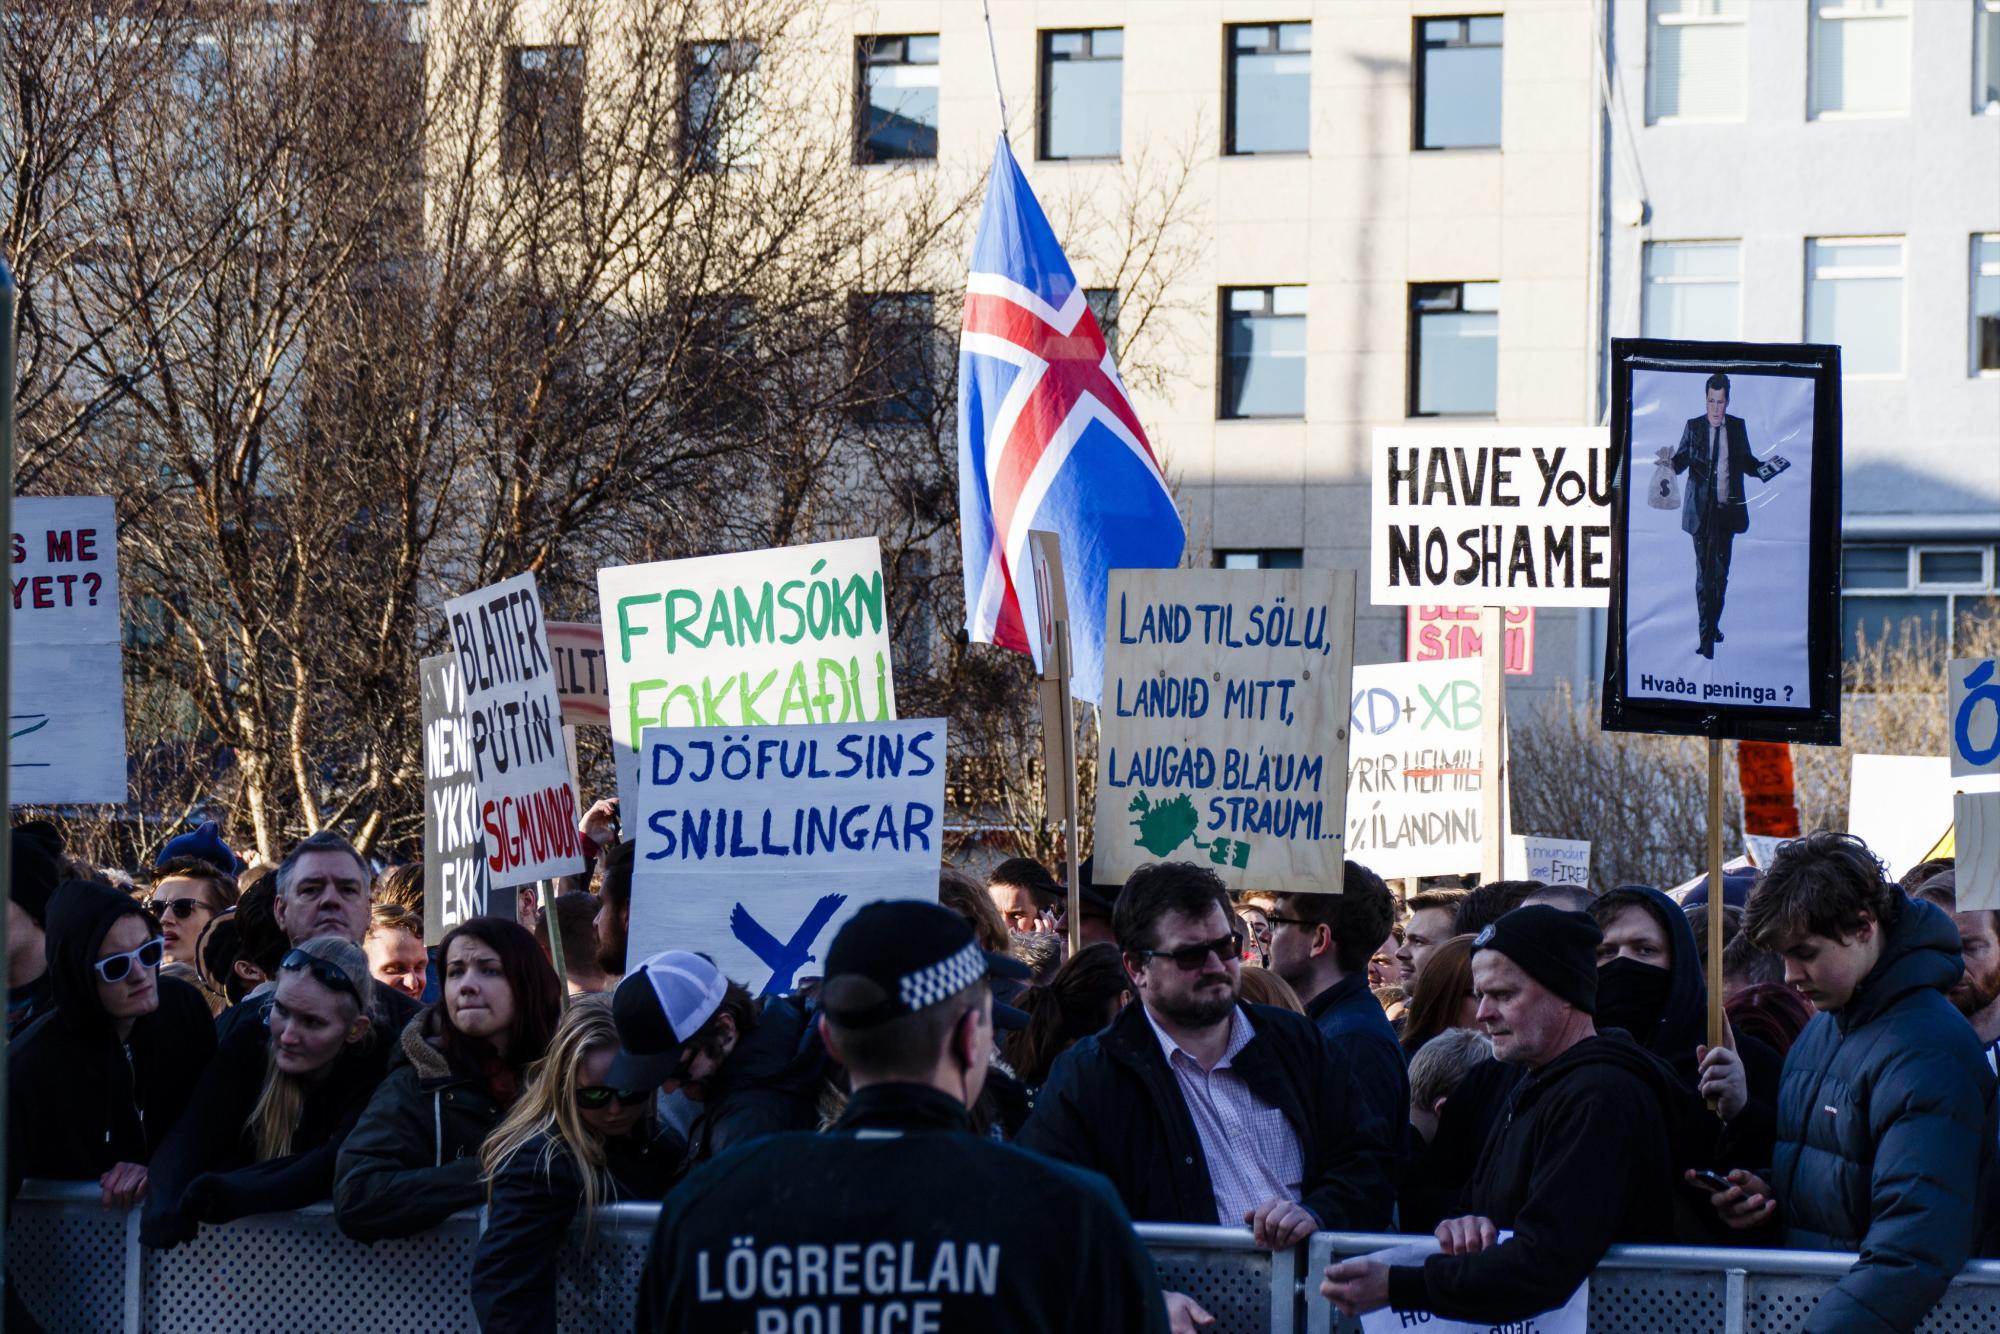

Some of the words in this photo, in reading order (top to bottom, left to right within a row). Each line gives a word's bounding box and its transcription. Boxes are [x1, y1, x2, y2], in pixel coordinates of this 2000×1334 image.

[1387, 447, 1522, 507] HAVE
[46, 529, 98, 562] ME
[1388, 525, 1449, 587] NO
[1454, 525, 1611, 588] SHAME
[11, 572, 103, 609] YET?
[617, 558, 883, 663] FRAMSÓKN
[453, 588, 549, 696] BLATTER
[1119, 591, 1192, 645] LAND
[1195, 603, 1243, 649] TIL
[1245, 597, 1331, 656] SÖLU,
[630, 651, 889, 753] FOKKAÐU
[1116, 676, 1210, 719] LANDIÐ
[1224, 679, 1296, 727] MITT,
[1641, 674, 1697, 695] Hvaða
[1703, 682, 1777, 704] peninga
[472, 690, 555, 783] PÚTÍN
[652, 731, 936, 786] DJÖFULSINS
[1109, 745, 1217, 789] LAUGAÐ
[1223, 745, 1323, 793] BLÁUM
[483, 783, 582, 874] SIGMUNDUR
[646, 802, 934, 861] SNILLINGAR
[1207, 796, 1342, 841] STRAUMI...
[442, 857, 488, 929] EKKI
[1552, 859, 1588, 883] FIRED
[698, 1236, 1000, 1301] LÖGREGLAN
